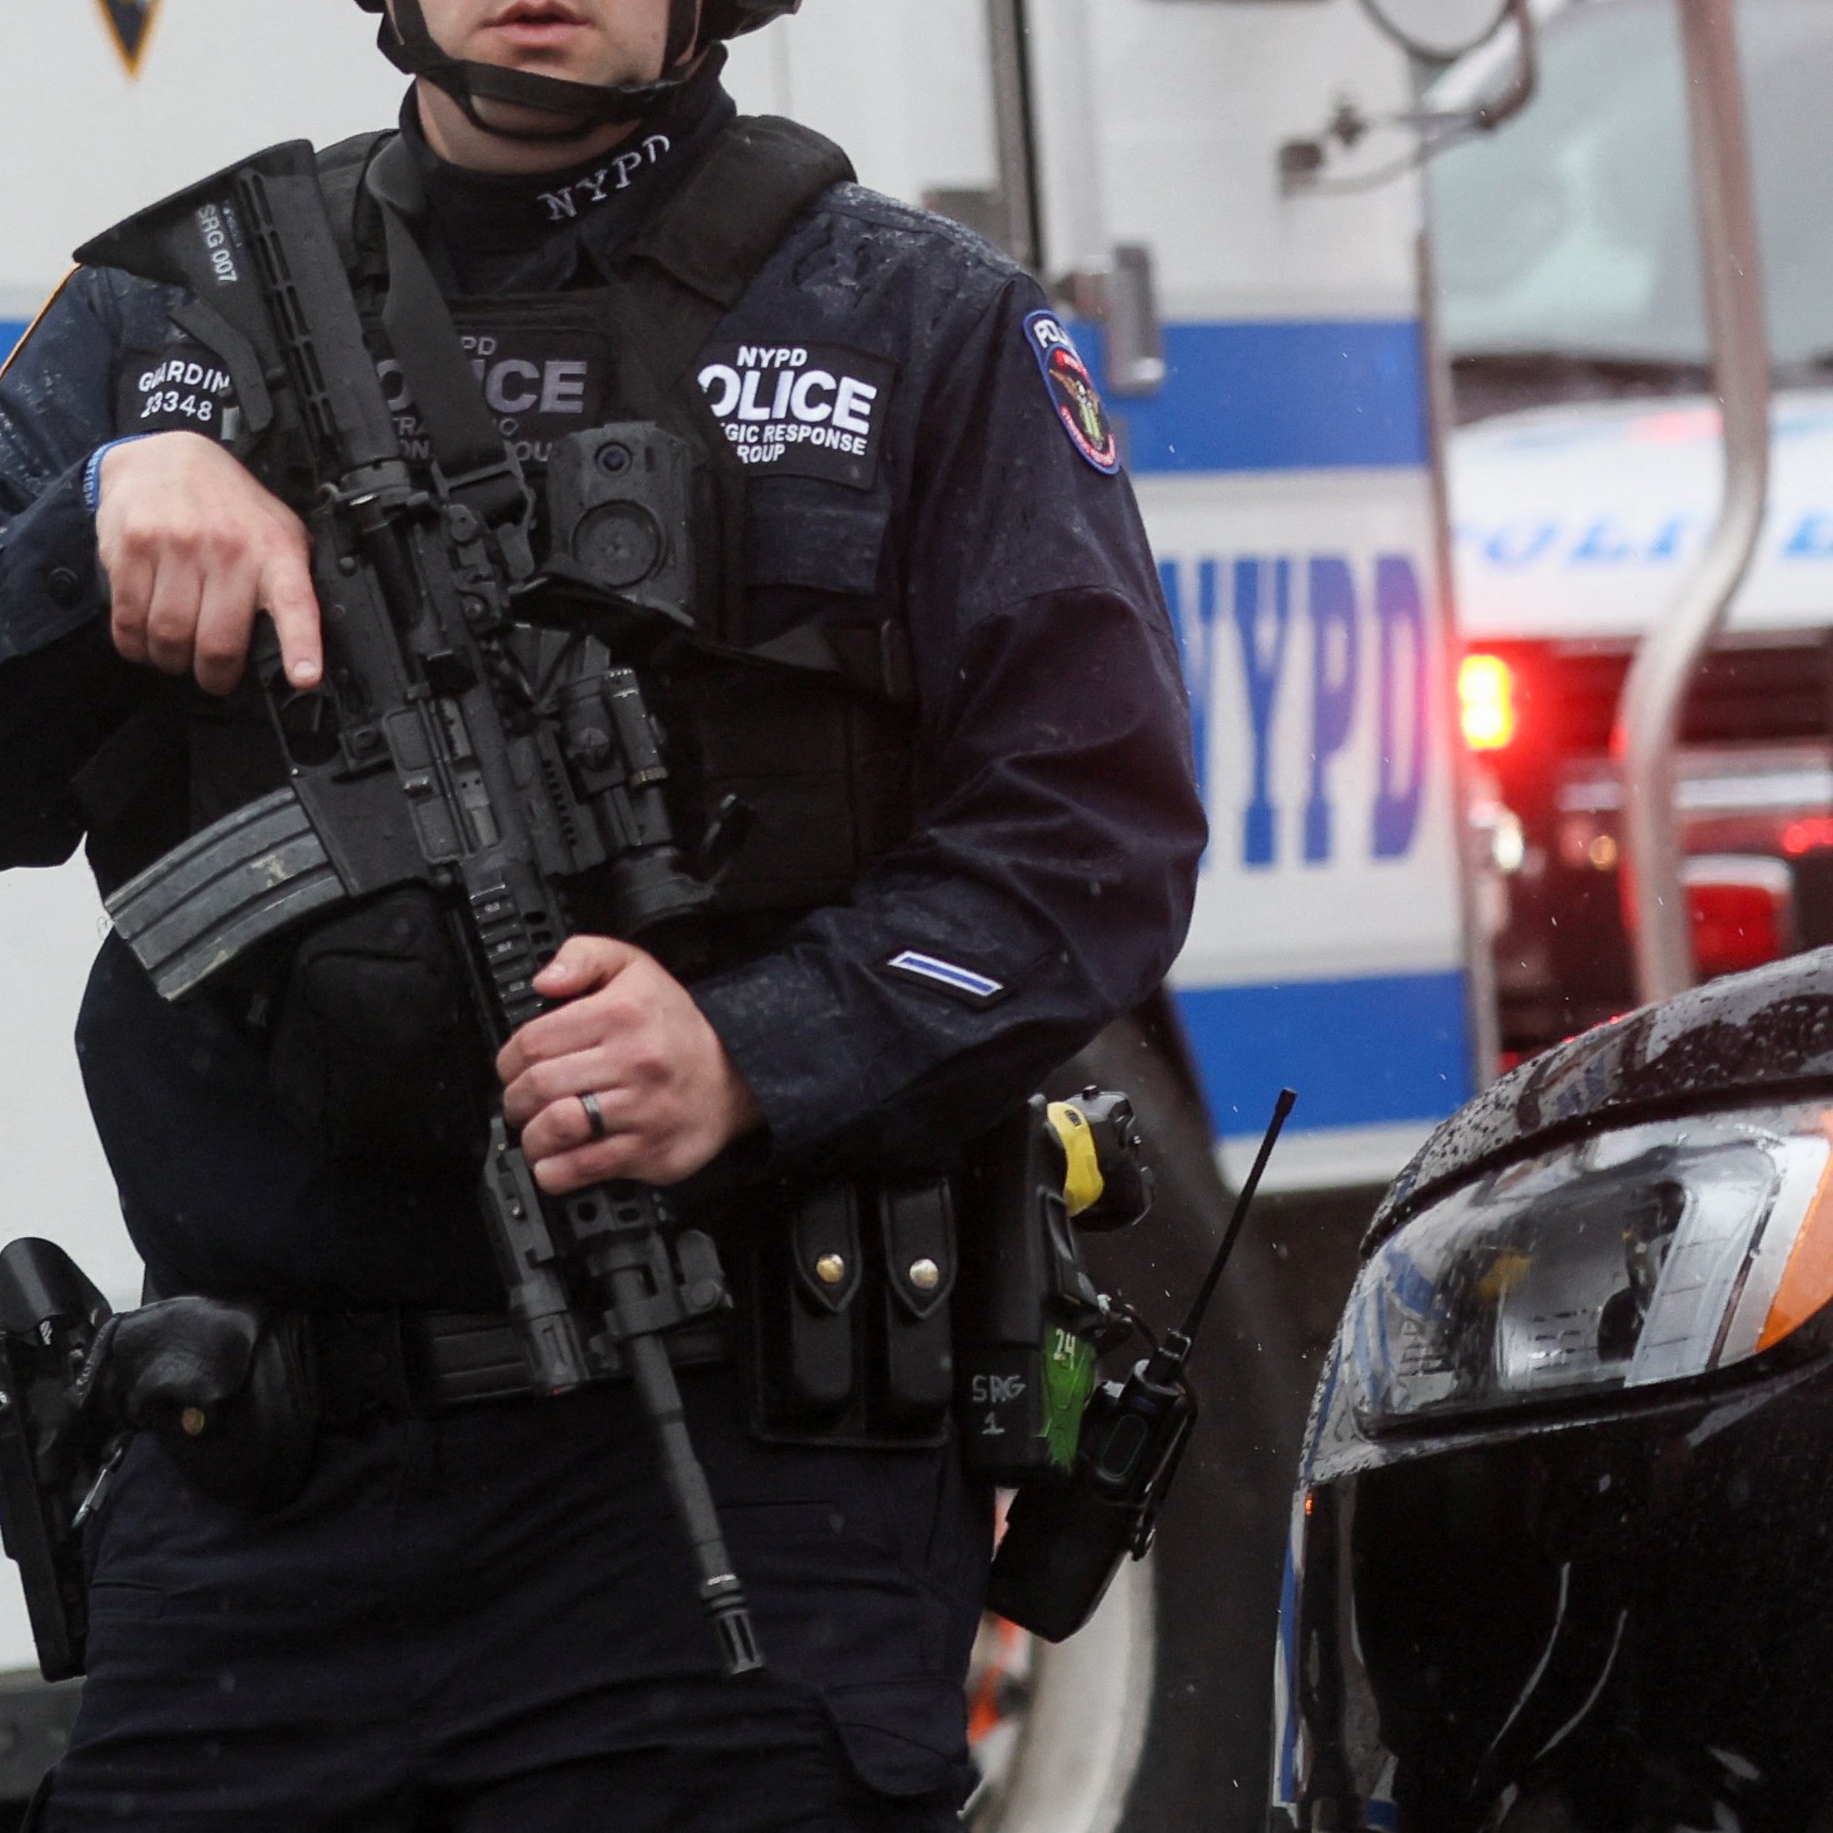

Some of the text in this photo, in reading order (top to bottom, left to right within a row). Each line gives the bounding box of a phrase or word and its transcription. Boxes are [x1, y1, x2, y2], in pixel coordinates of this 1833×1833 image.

[197, 203, 225, 249] SRG
[211, 249, 238, 283] 007
[737, 345, 808, 368] NYPD
[697, 363, 877, 435] OLICE
[736, 443, 786, 464] ROUP
[762, 424, 868, 456] RESPONSE
